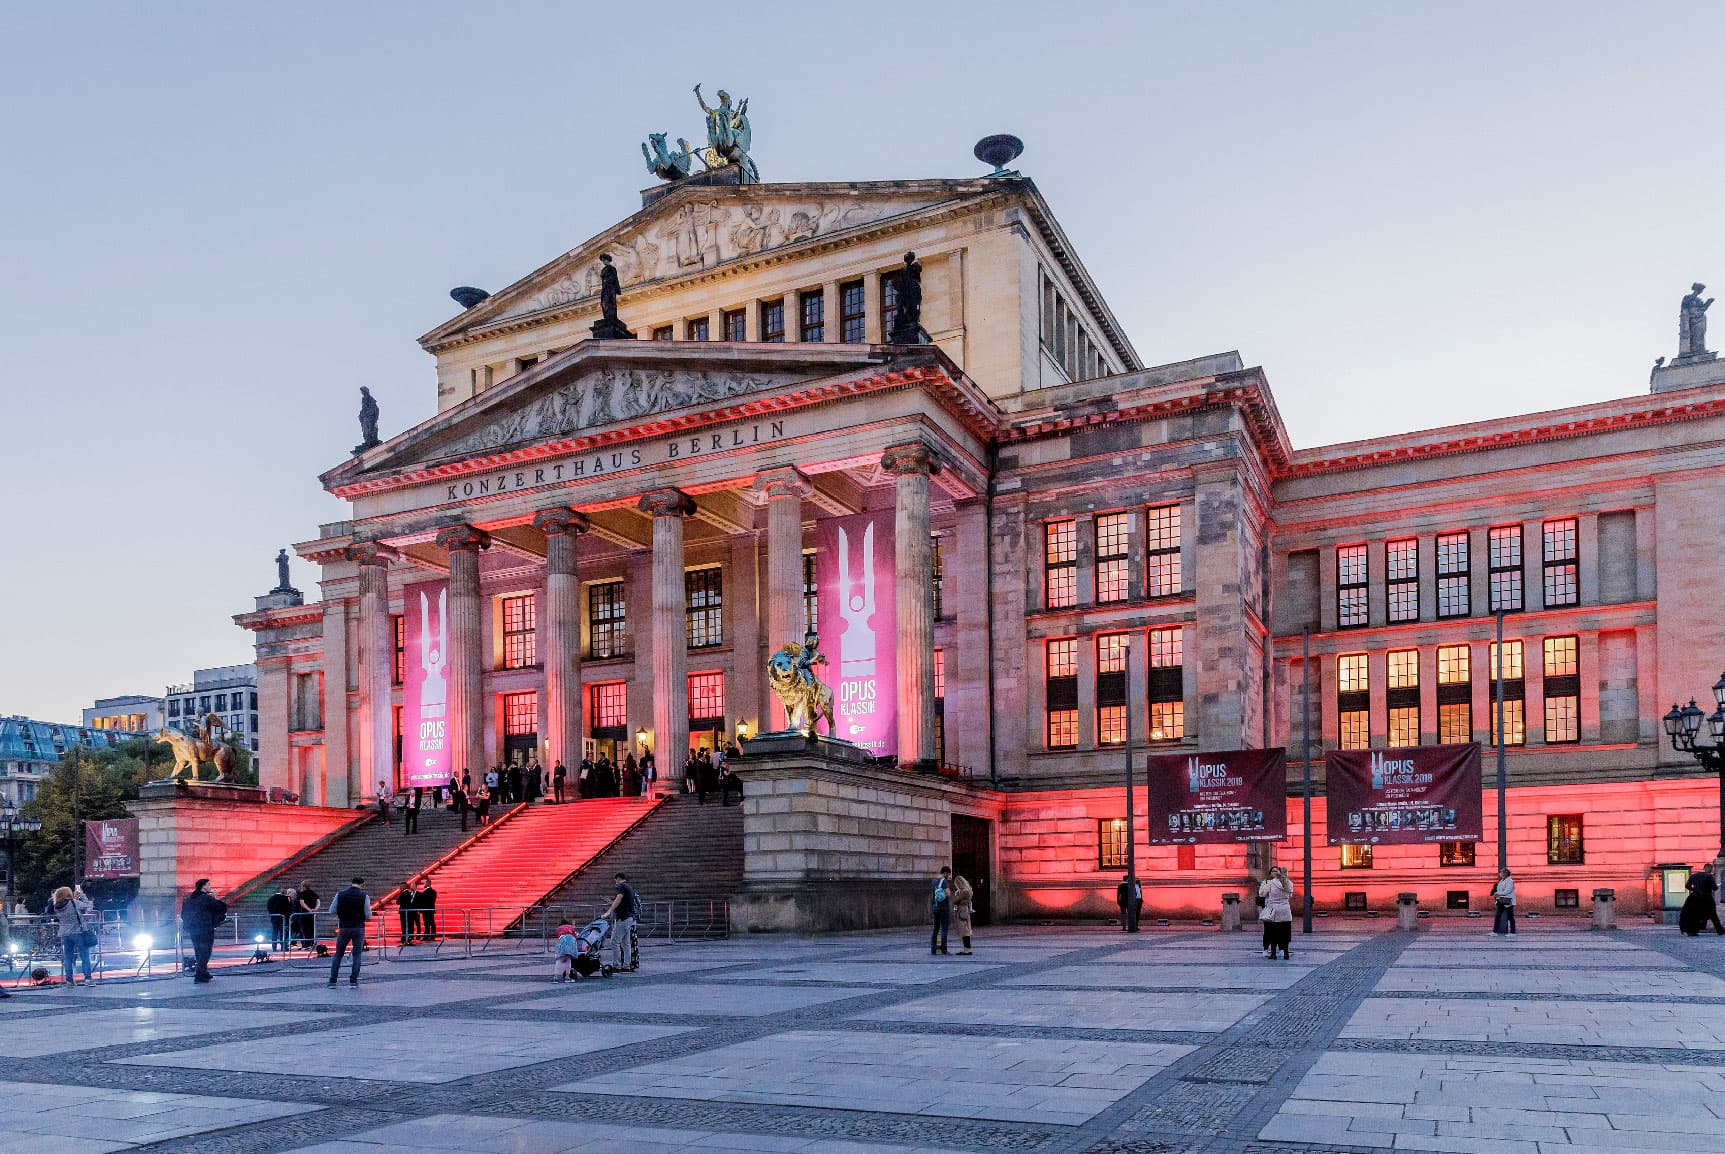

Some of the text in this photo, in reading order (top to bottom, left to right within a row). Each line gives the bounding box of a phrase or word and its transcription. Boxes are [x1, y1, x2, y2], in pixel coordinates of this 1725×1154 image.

[448, 420, 785, 500] KONZERTHAUS BERLIN
[840, 680, 876, 702] OPUS
[840, 701, 875, 715] KLASSIK
[420, 721, 445, 739] OPUS
[1199, 763, 1227, 779] OPUS
[1383, 759, 1415, 775] OPUS
[1199, 776, 1243, 788] KLASSIK 2018
[1384, 773, 1433, 785] KLASSIK 2018
